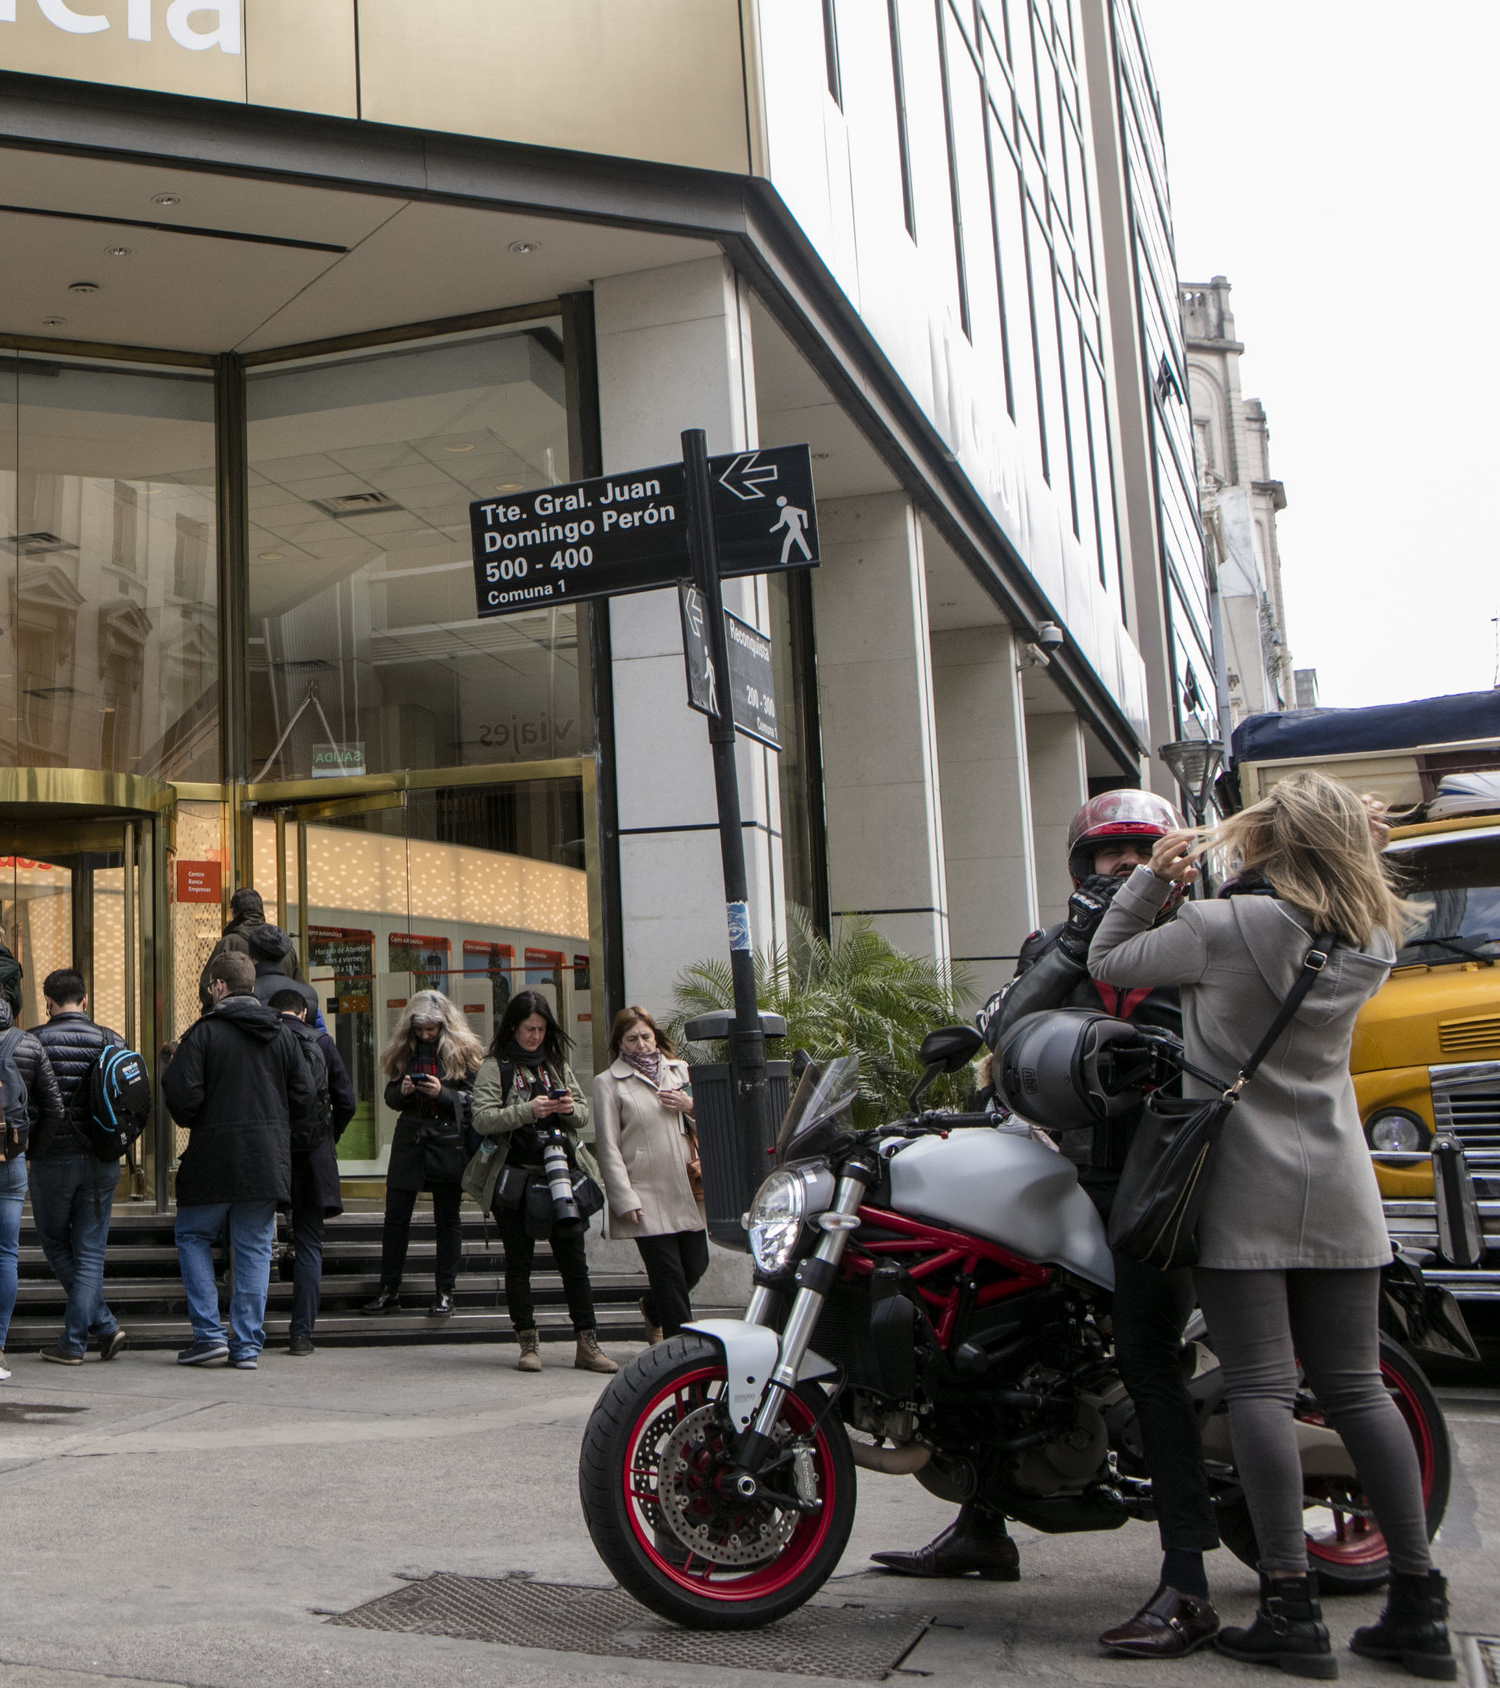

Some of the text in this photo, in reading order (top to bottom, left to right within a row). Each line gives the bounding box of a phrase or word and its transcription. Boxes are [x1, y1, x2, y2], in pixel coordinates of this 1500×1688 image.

[480, 479, 661, 525] Tte. Gral. Juan
[484, 503, 675, 553] Domingo Perón
[485, 557, 528, 583] 500
[550, 546, 594, 571] 400
[487, 579, 566, 605] Comuna 1
[729, 618, 770, 662] Reconquista
[746, 685, 759, 709] 200
[763, 694, 776, 718] 300
[756, 716, 774, 738] Comuna
[802, 1460, 812, 1496] brembo
